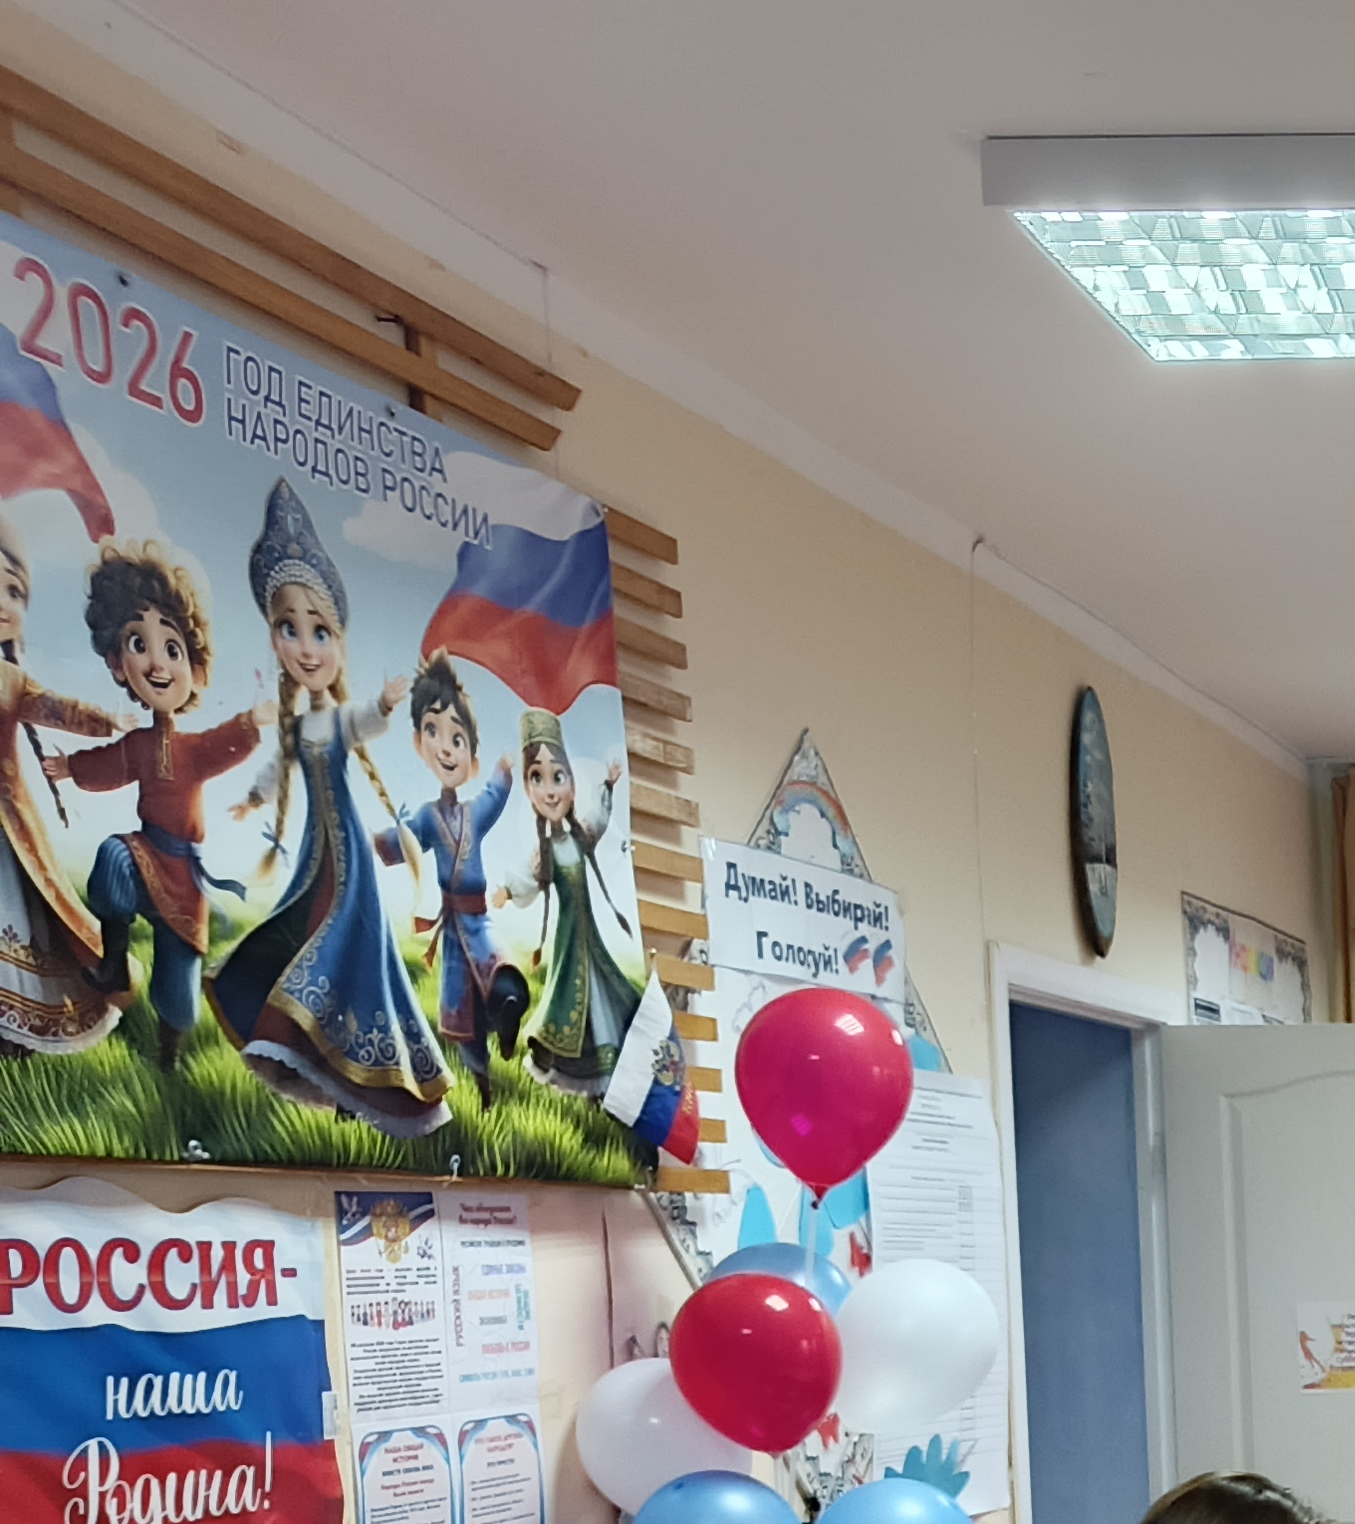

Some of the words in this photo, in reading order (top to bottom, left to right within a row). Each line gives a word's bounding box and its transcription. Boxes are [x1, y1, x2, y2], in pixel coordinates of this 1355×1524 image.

[14, 256, 204, 424] 2026
[225, 345, 286, 410] ГОД
[297, 377, 449, 483] ЕДИНСТВА
[225, 396, 373, 495] НАРОДОВ
[381, 466, 493, 549] РОССИИ
[724, 861, 798, 907] Думай!
[0, 1237, 298, 1316] РОССИЯ-
[105, 1367, 244, 1421] наша
